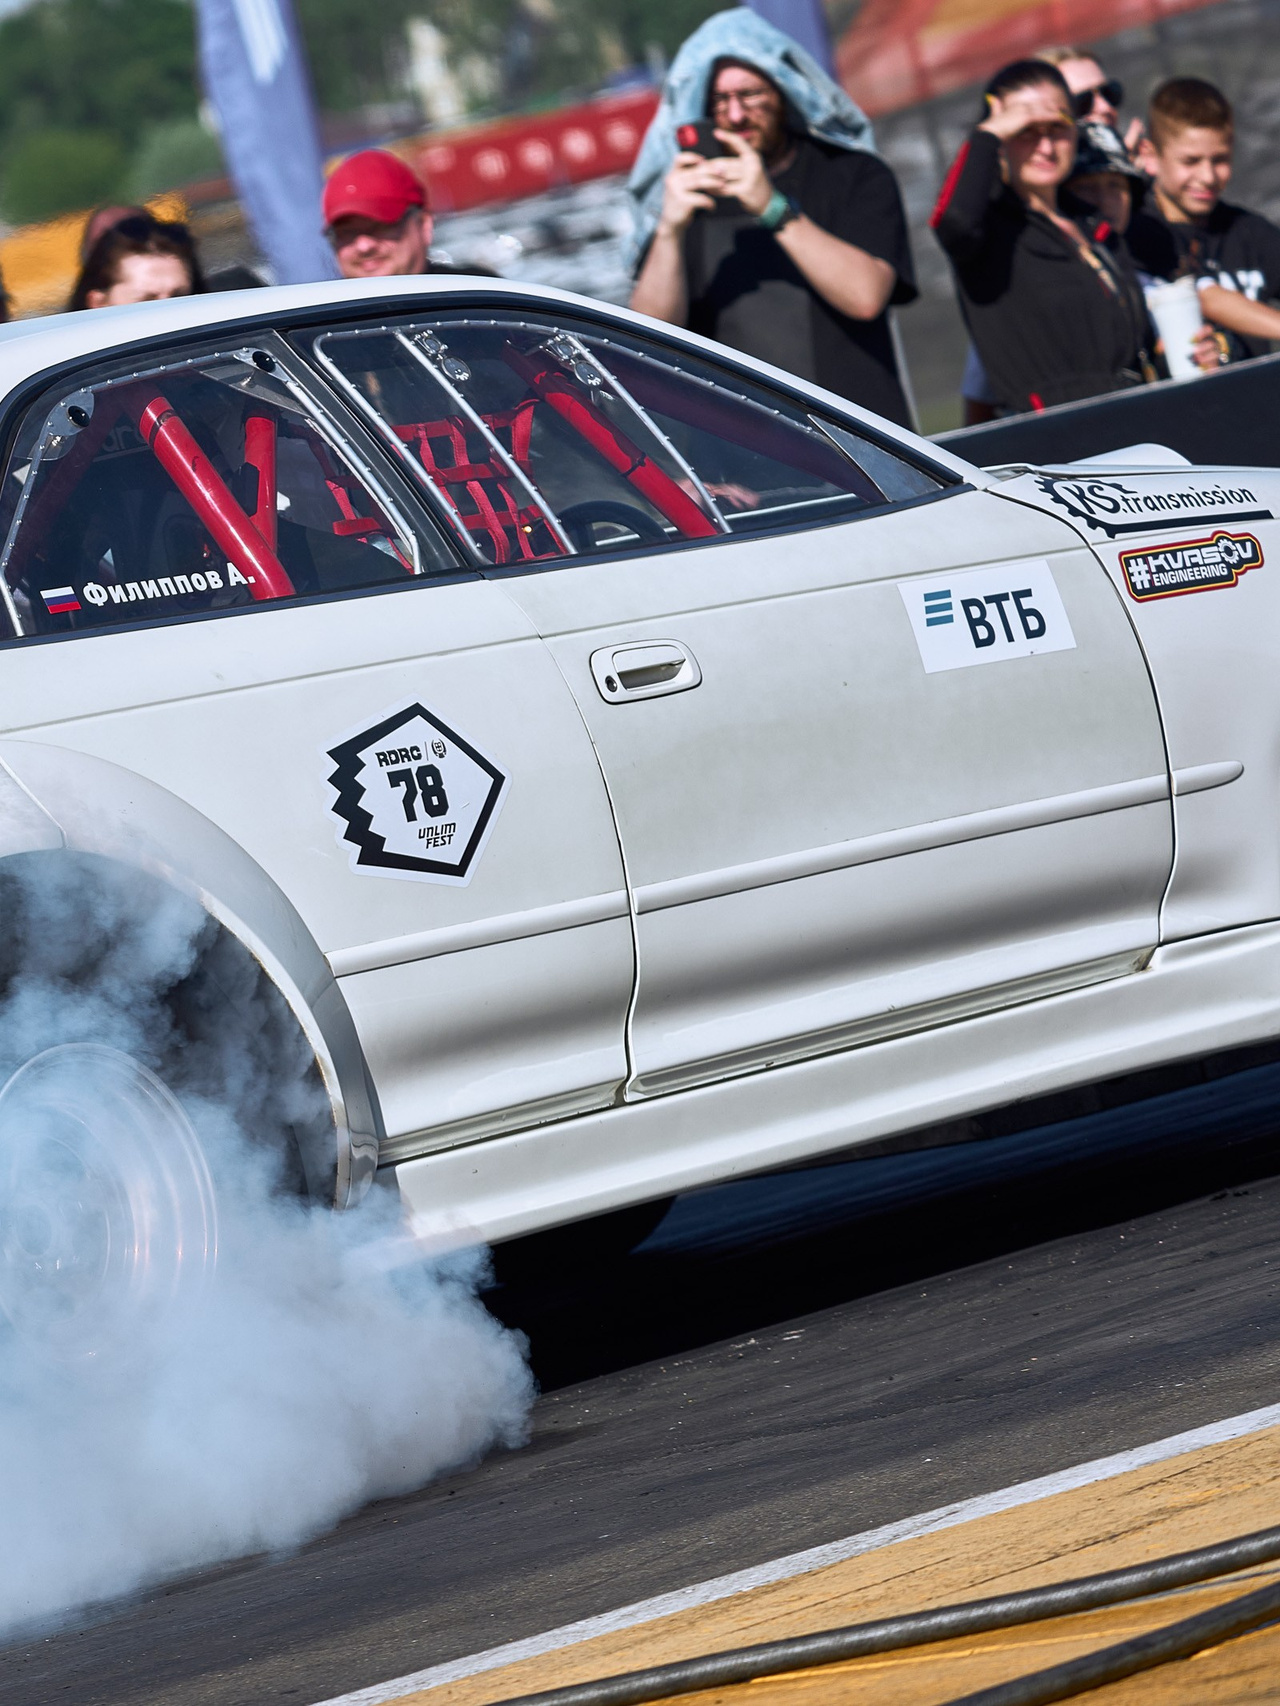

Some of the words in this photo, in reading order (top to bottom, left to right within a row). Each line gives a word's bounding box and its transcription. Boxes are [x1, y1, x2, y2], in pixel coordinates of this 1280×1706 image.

[82, 570, 224, 607] Филиппов
[226, 562, 256, 587] А.
[1153, 563, 1228, 587] ENGINEERING
[960, 588, 1047, 649] ВТБ
[375, 745, 423, 767] RDRC
[386, 763, 450, 823] 78
[418, 822, 457, 840] UNLIM
[425, 834, 454, 850] FEST
